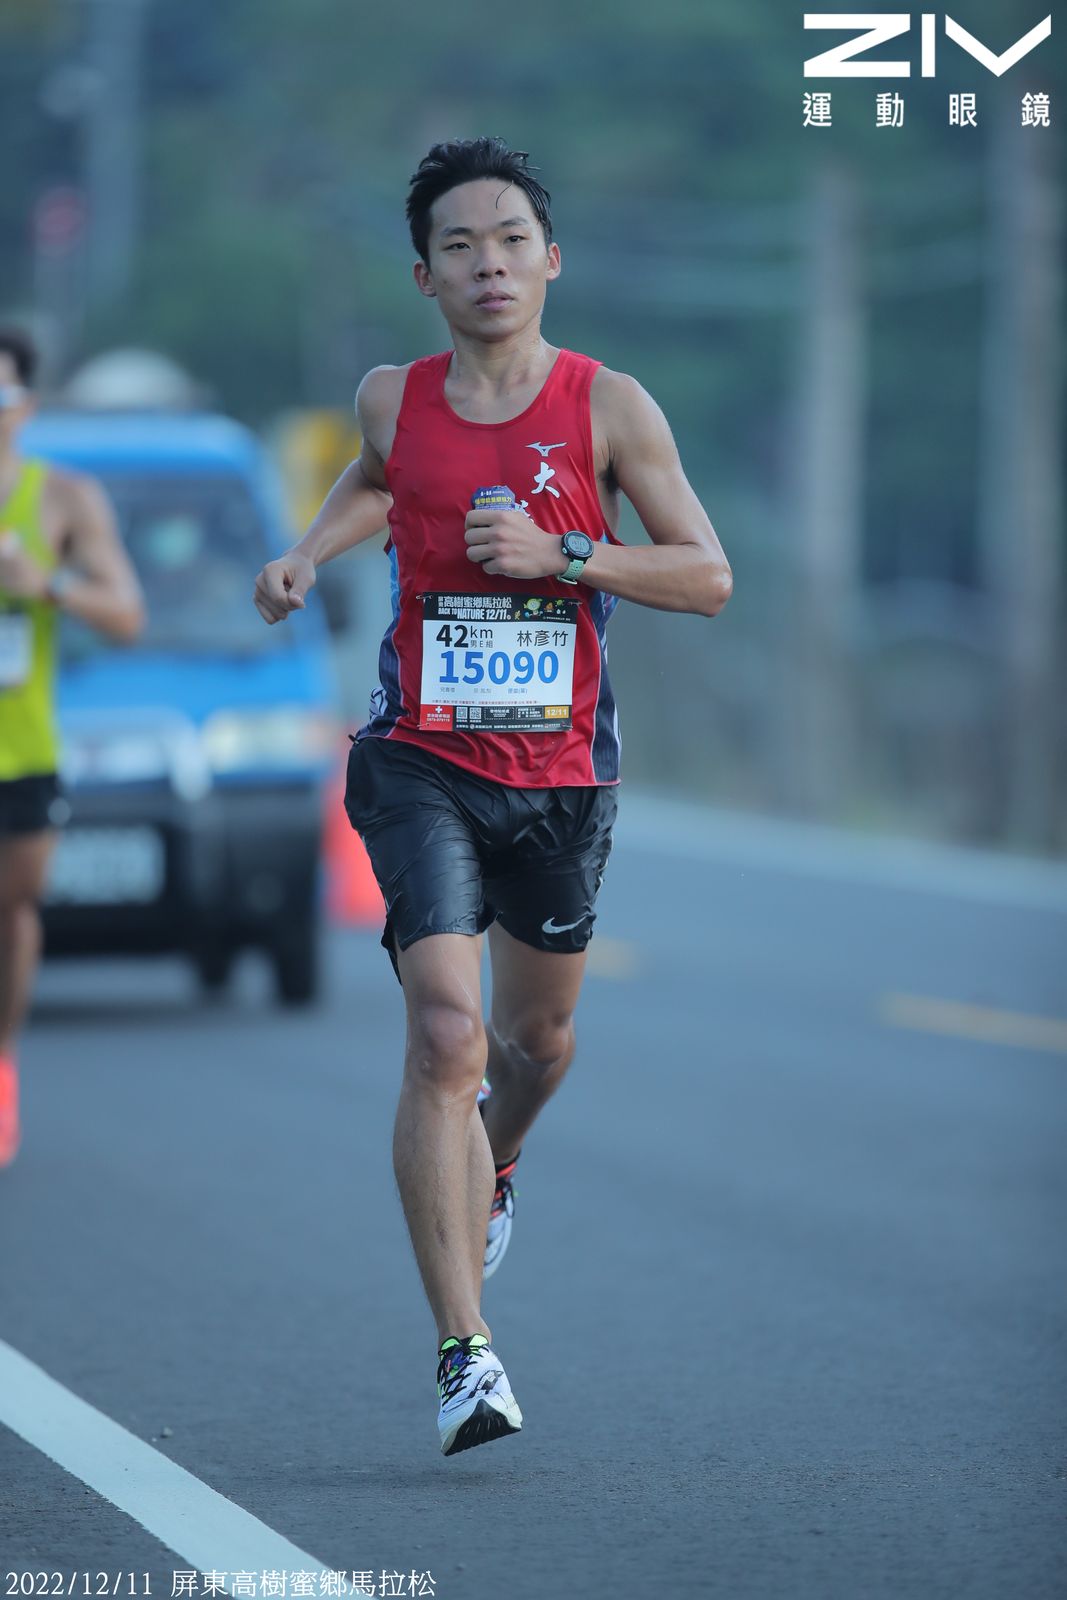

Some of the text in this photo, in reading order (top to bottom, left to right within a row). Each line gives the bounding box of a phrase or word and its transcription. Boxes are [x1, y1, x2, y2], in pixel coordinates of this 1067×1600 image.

[457, 608, 485, 620] NATURE
[486, 609, 507, 620] 12/11
[436, 625, 493, 648] 42 km
[517, 630, 569, 647] 林彥竹
[439, 651, 559, 685] 15090
